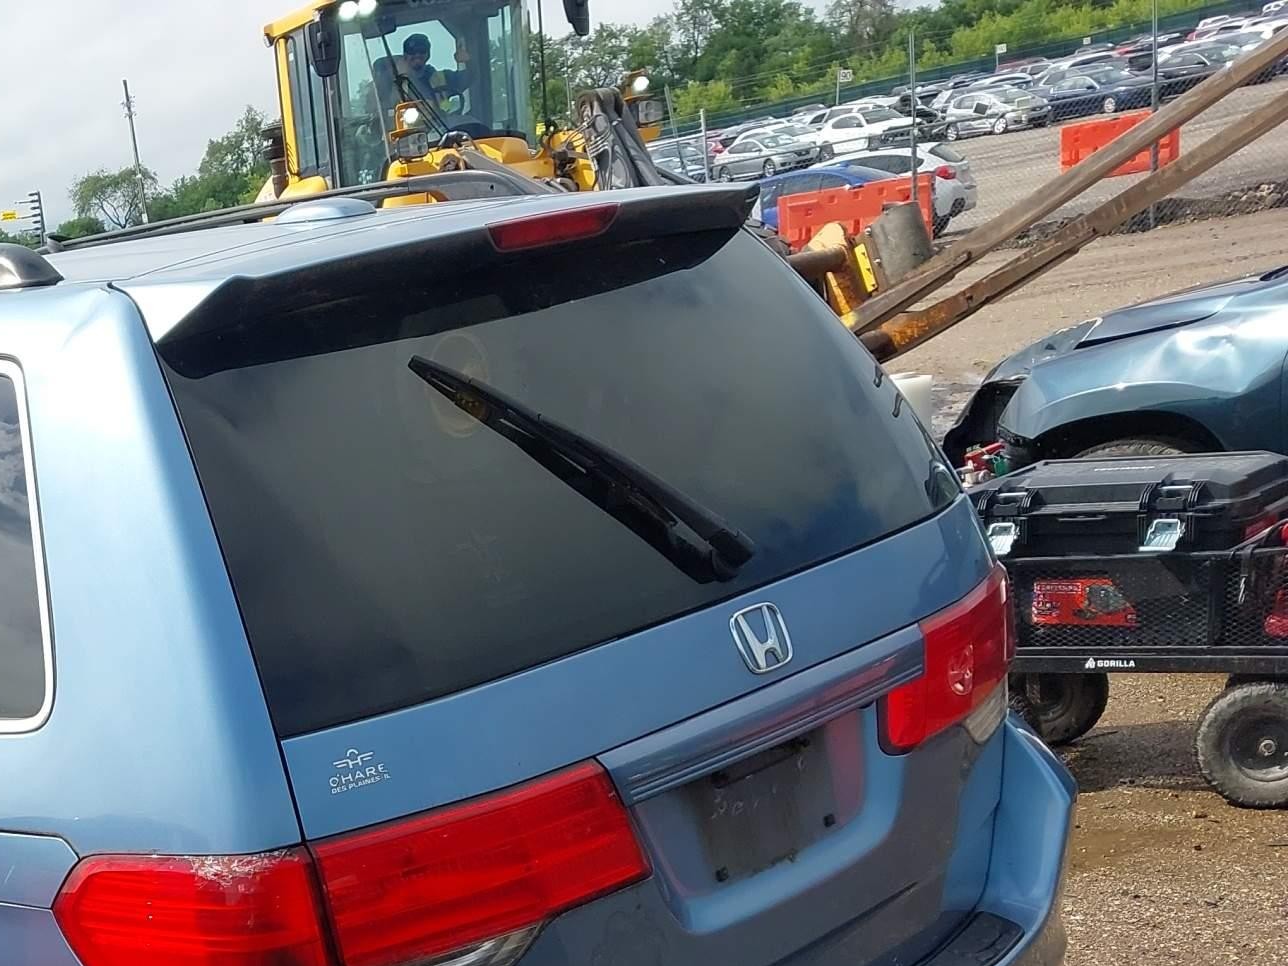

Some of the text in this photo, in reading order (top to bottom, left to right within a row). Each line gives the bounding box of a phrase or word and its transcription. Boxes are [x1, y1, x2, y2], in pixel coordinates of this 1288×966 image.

[1097, 660, 1136, 668] GORILLA
[329, 763, 388, 787] O'HARE
[331, 784, 348, 794] DES
